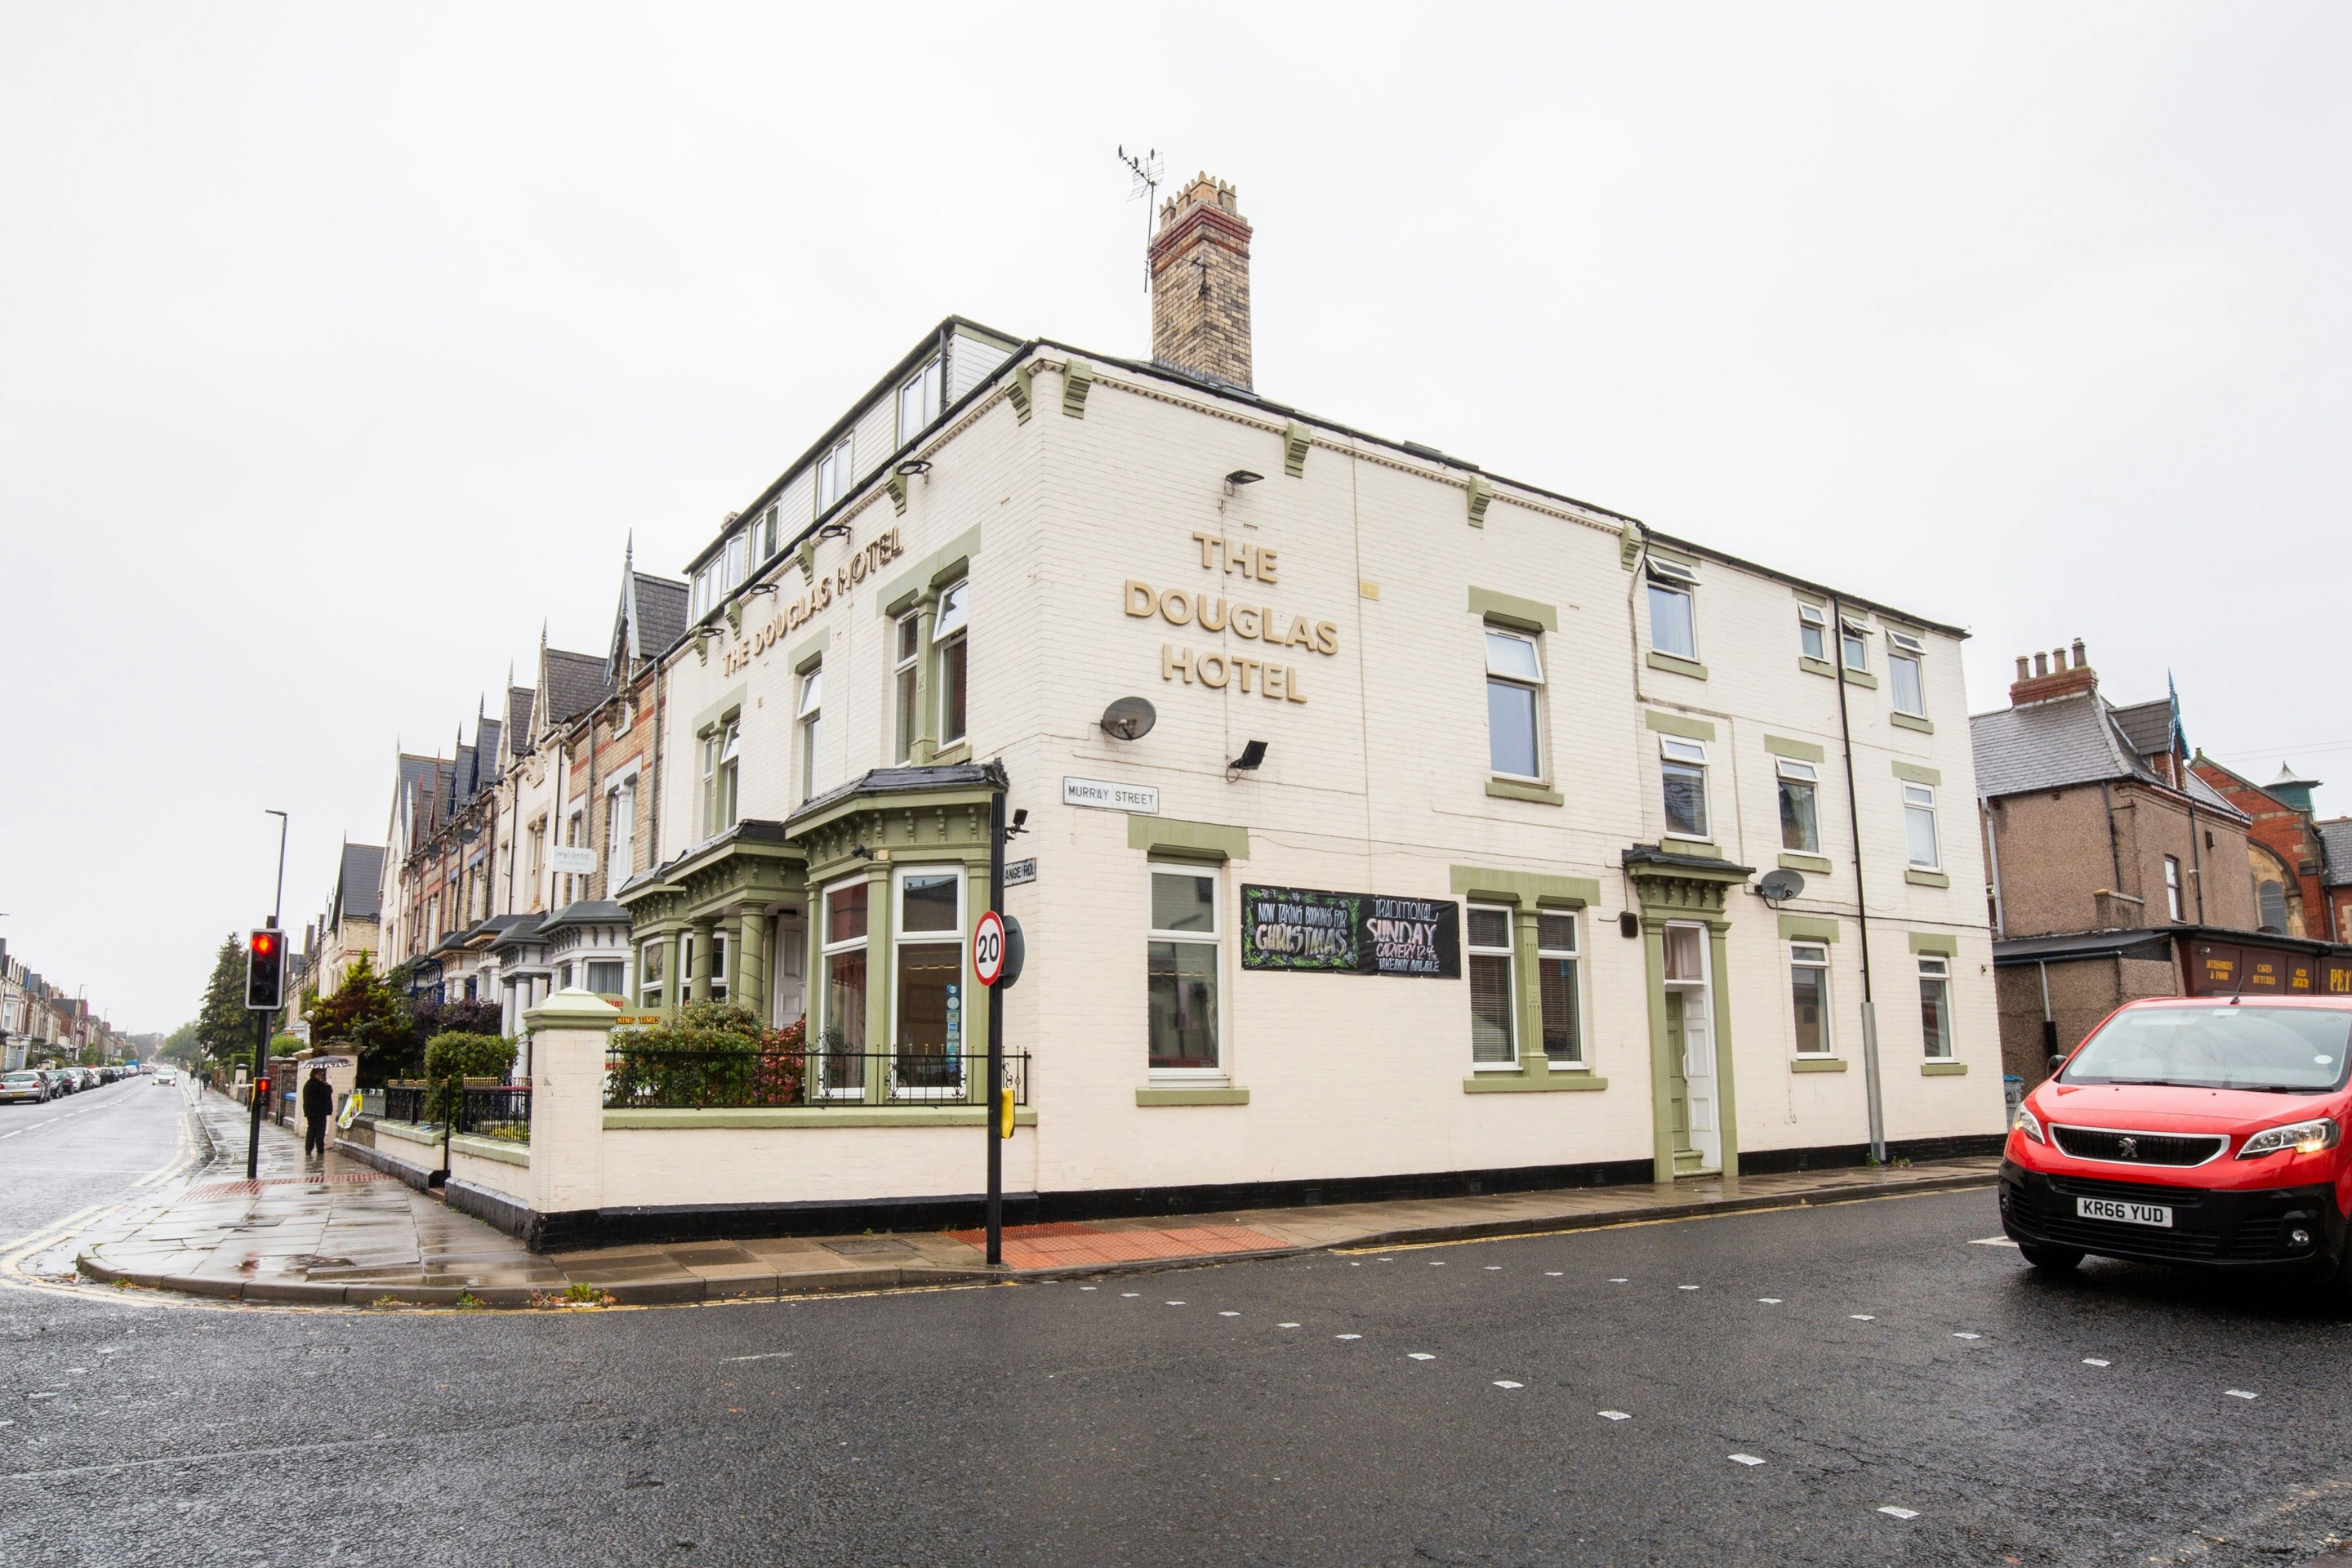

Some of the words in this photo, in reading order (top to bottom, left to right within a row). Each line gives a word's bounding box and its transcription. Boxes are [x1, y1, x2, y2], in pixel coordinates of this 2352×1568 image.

[1192, 531, 1278, 584] THE
[723, 638, 750, 679] THE
[753, 577, 832, 657] DOUGLAS
[837, 524, 904, 595] HOTEL
[1125, 578, 1339, 656] DOUGLAS
[1162, 643, 1308, 704] HOTEL
[1068, 785, 1108, 800] MURRAY
[1115, 791, 1154, 804] STREET
[1004, 866, 1022, 880] ANGE
[1258, 902, 1275, 922] NOW
[1278, 903, 1303, 924] TAKING
[1305, 906, 1334, 927] BOOKINGS
[1334, 909, 1348, 928] FOR
[1373, 899, 1439, 922] TRADITIONAL
[1255, 923, 1348, 956] CHRISTMAS
[1365, 918, 1437, 946] SUNDAY
[978, 933, 1000, 964] 20
[1376, 942, 1416, 959] CARVERY
[2216, 971, 2229, 980] FOOD
[2257, 964, 2273, 973] CAGES
[616, 1016, 635, 1024] NING
[639, 1016, 661, 1024] TIMES
[2084, 1200, 2125, 1218] KR66
[2131, 1205, 2163, 1223] YUD
